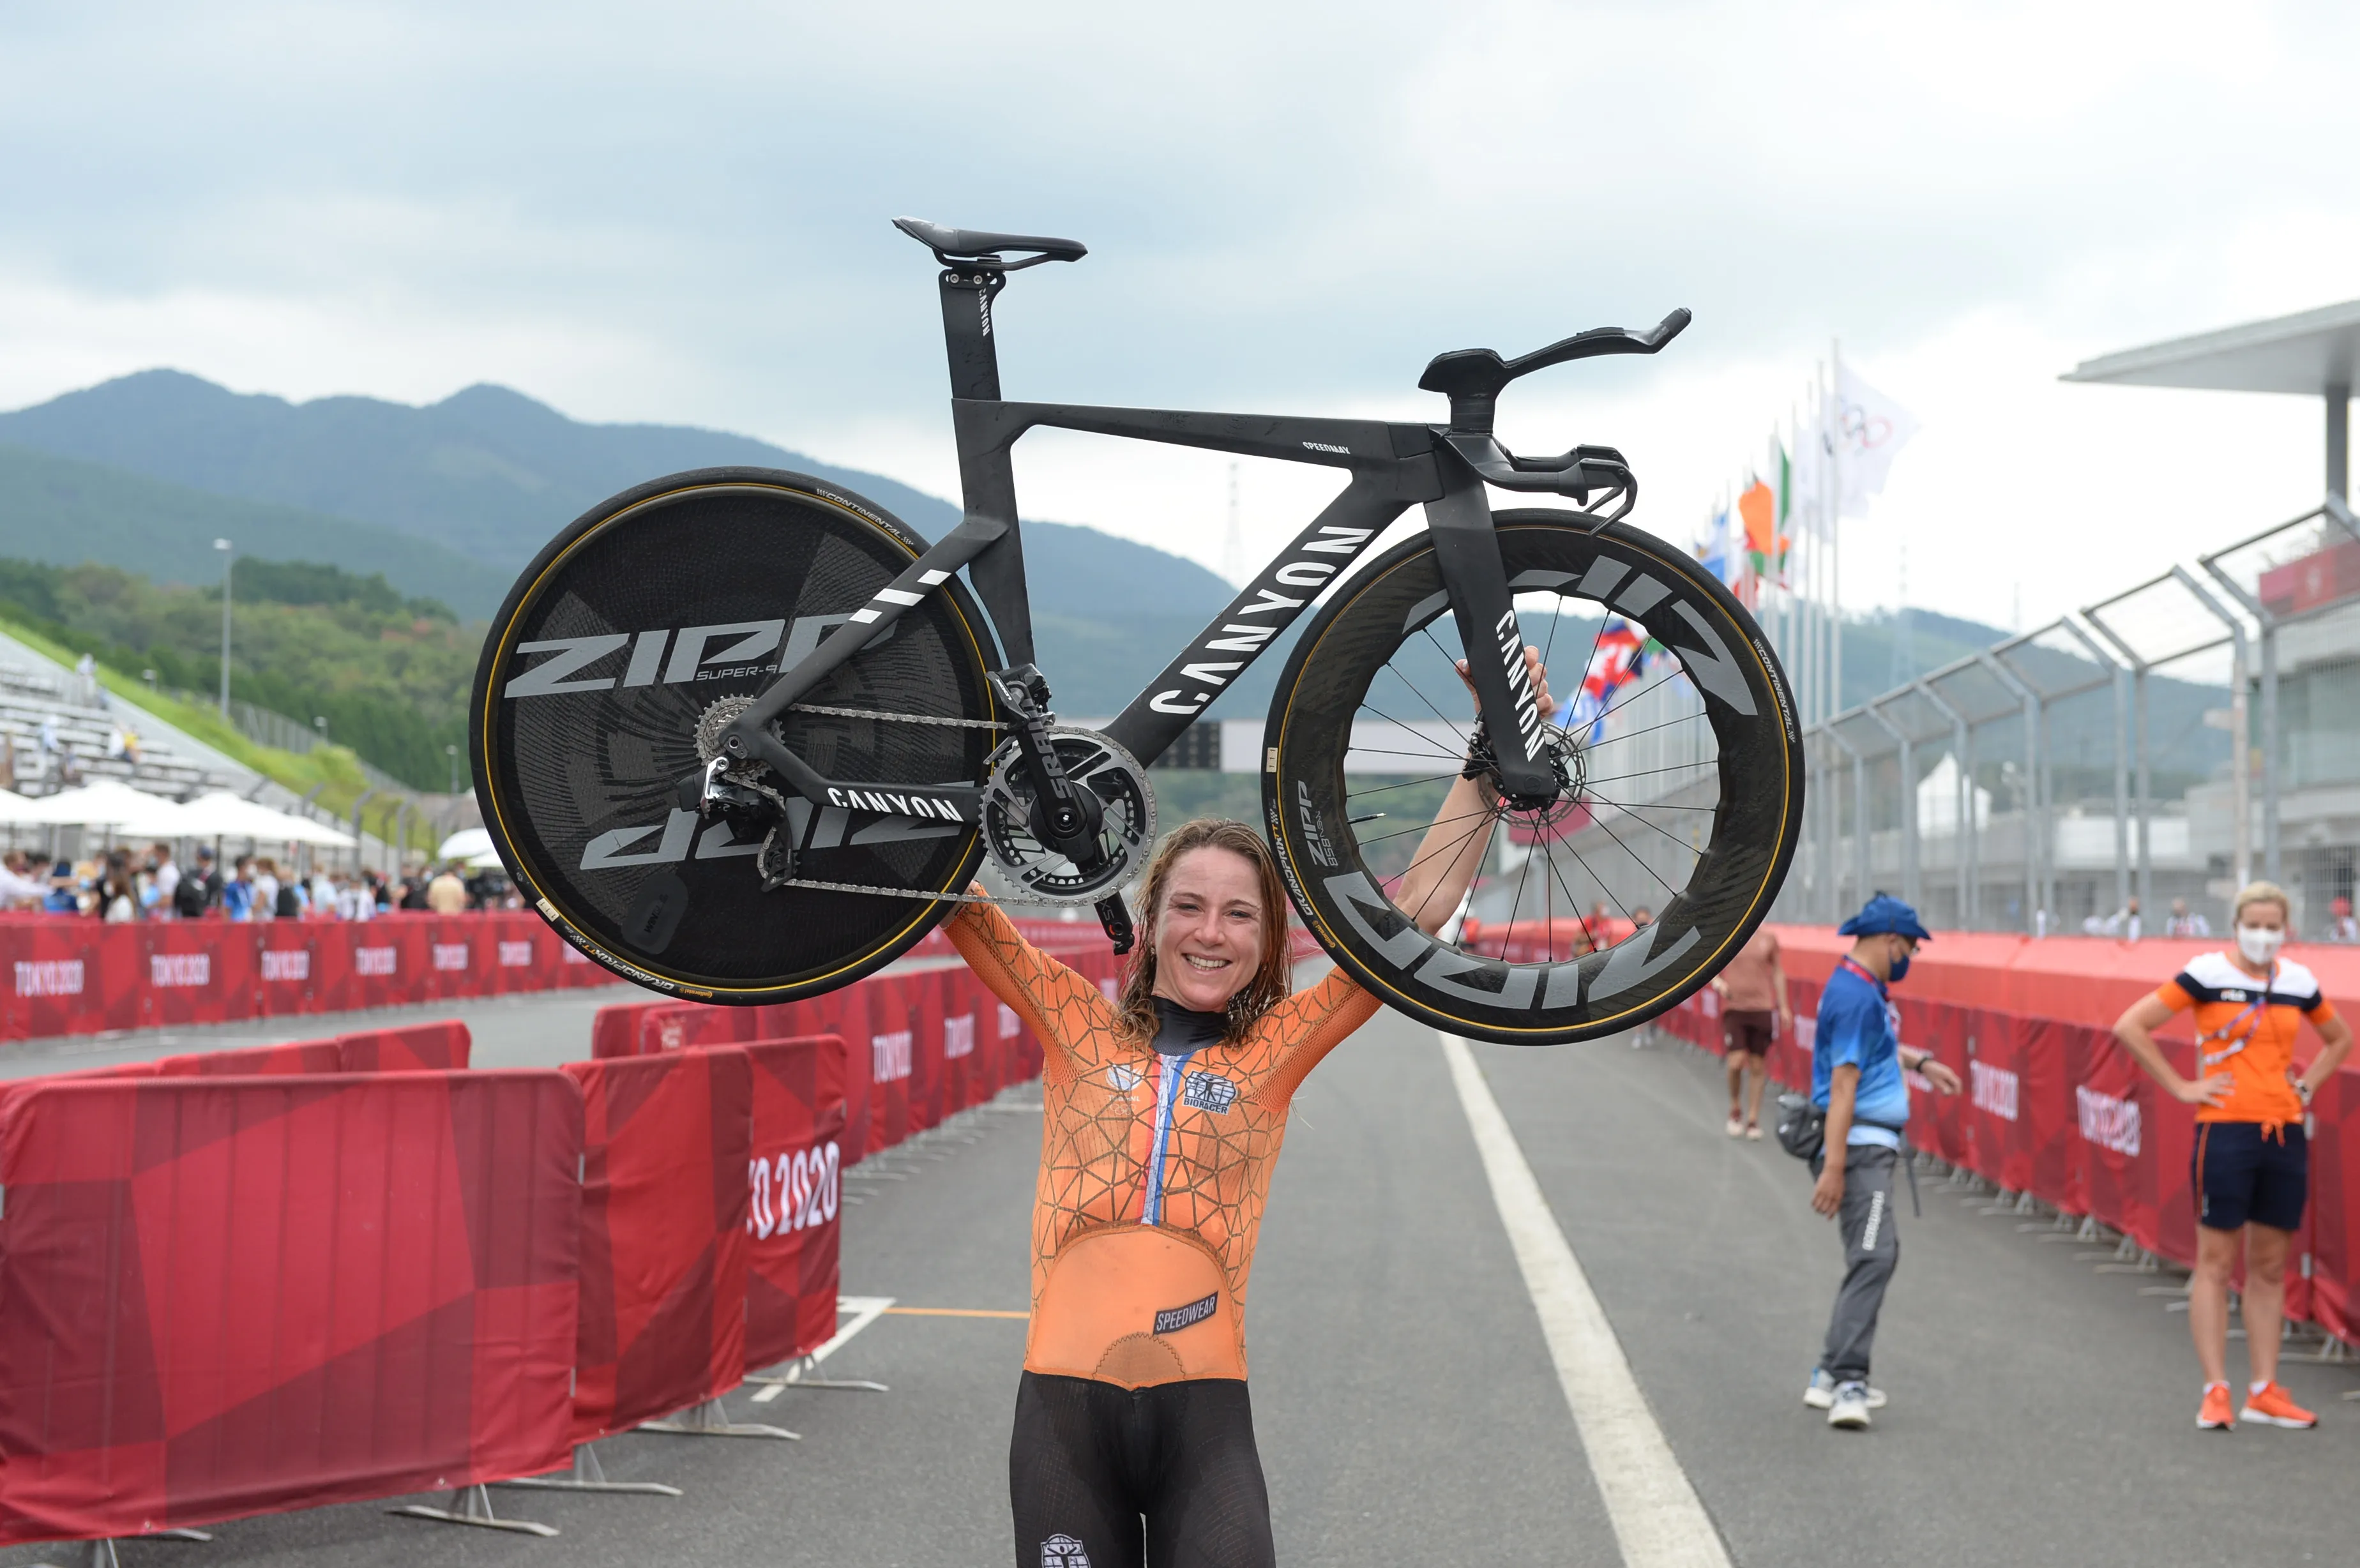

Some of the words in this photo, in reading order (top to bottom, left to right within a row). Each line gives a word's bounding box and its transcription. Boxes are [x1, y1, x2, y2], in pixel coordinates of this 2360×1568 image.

[978, 288, 990, 336] CANYON
[826, 493, 901, 539] CONTINENTAL
[1149, 525, 1375, 714] CANYON
[696, 665, 778, 681] SUPER-9
[1495, 609, 1545, 763] CANYON
[1758, 649, 1792, 730] CONTINENTAL
[828, 787, 964, 822] CANYON
[1297, 780, 1329, 867] ZIPP
[1321, 838, 1339, 866] 858
[1183, 1097, 1228, 1115] BIORACER
[775, 1140, 840, 1236] 2020
[1156, 1296, 1216, 1332] SPEEDWEAR
